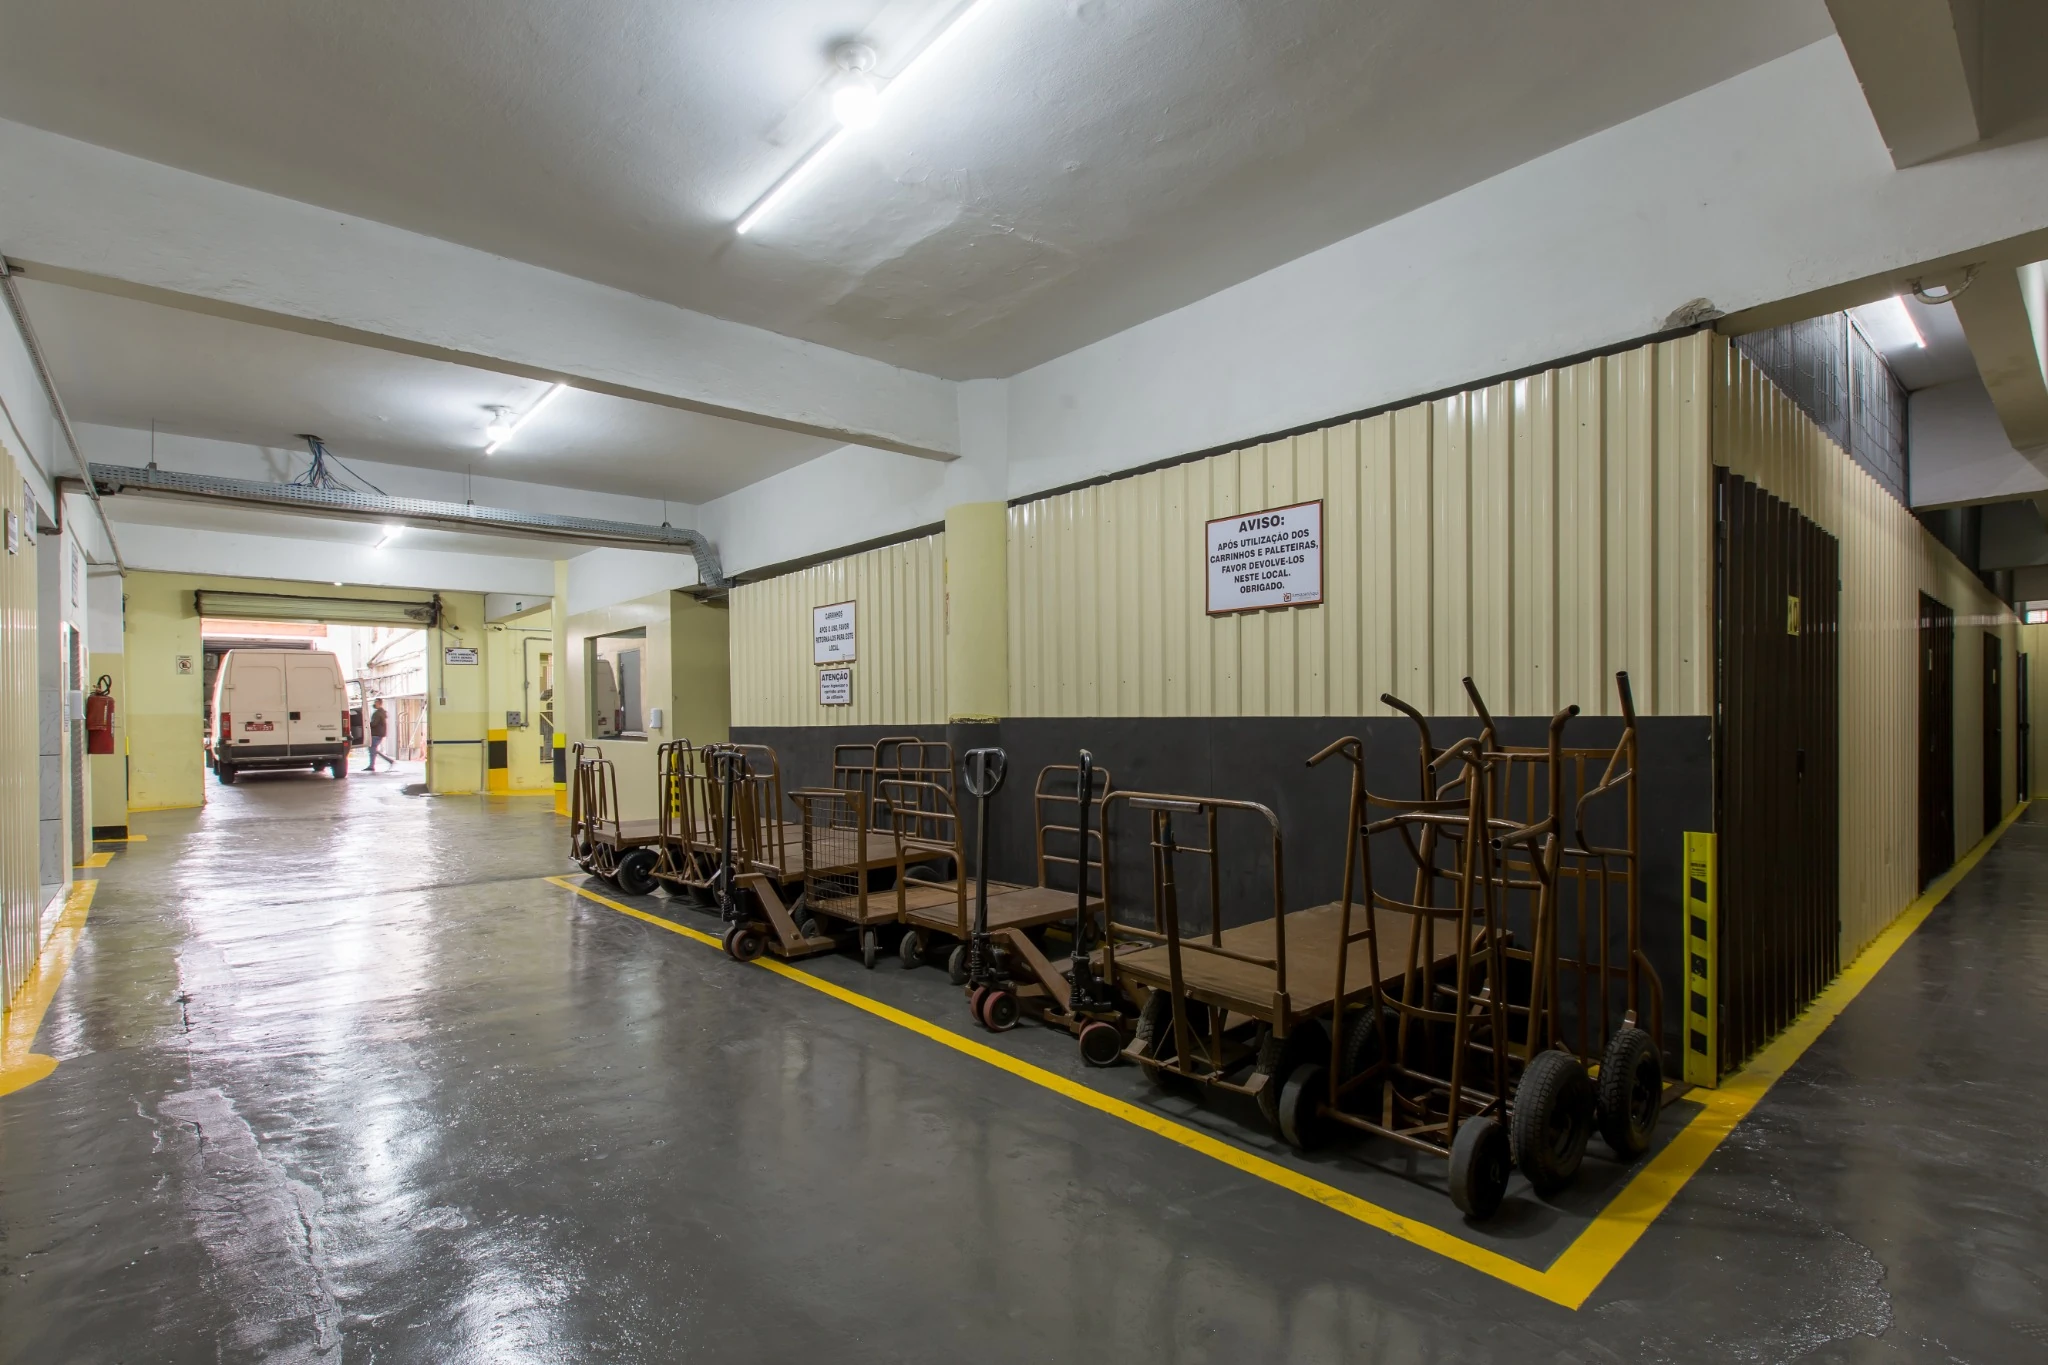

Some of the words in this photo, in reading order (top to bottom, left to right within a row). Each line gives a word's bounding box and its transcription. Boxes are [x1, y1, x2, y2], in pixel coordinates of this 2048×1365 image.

[1239, 515, 1285, 533] AVISO:
[1218, 539, 1239, 551] APÓS
[1240, 531, 1289, 548] UTILIZAÇÃO
[1291, 529, 1310, 540] DOS
[1210, 549, 1256, 563] CARRINHOS
[1257, 548, 1263, 556] E
[1264, 540, 1319, 555] PALETEIRAS,
[1221, 562, 1247, 573] FAVOR
[1249, 554, 1305, 570] DEVOLVE-LOS
[1234, 573, 1260, 583] NESTE
[1261, 569, 1291, 580] LOCAL.
[1239, 581, 1285, 594] OBRIGADO.
[839, 623, 849, 631] FAVOR
[821, 671, 848, 682] ATENÇÃO
